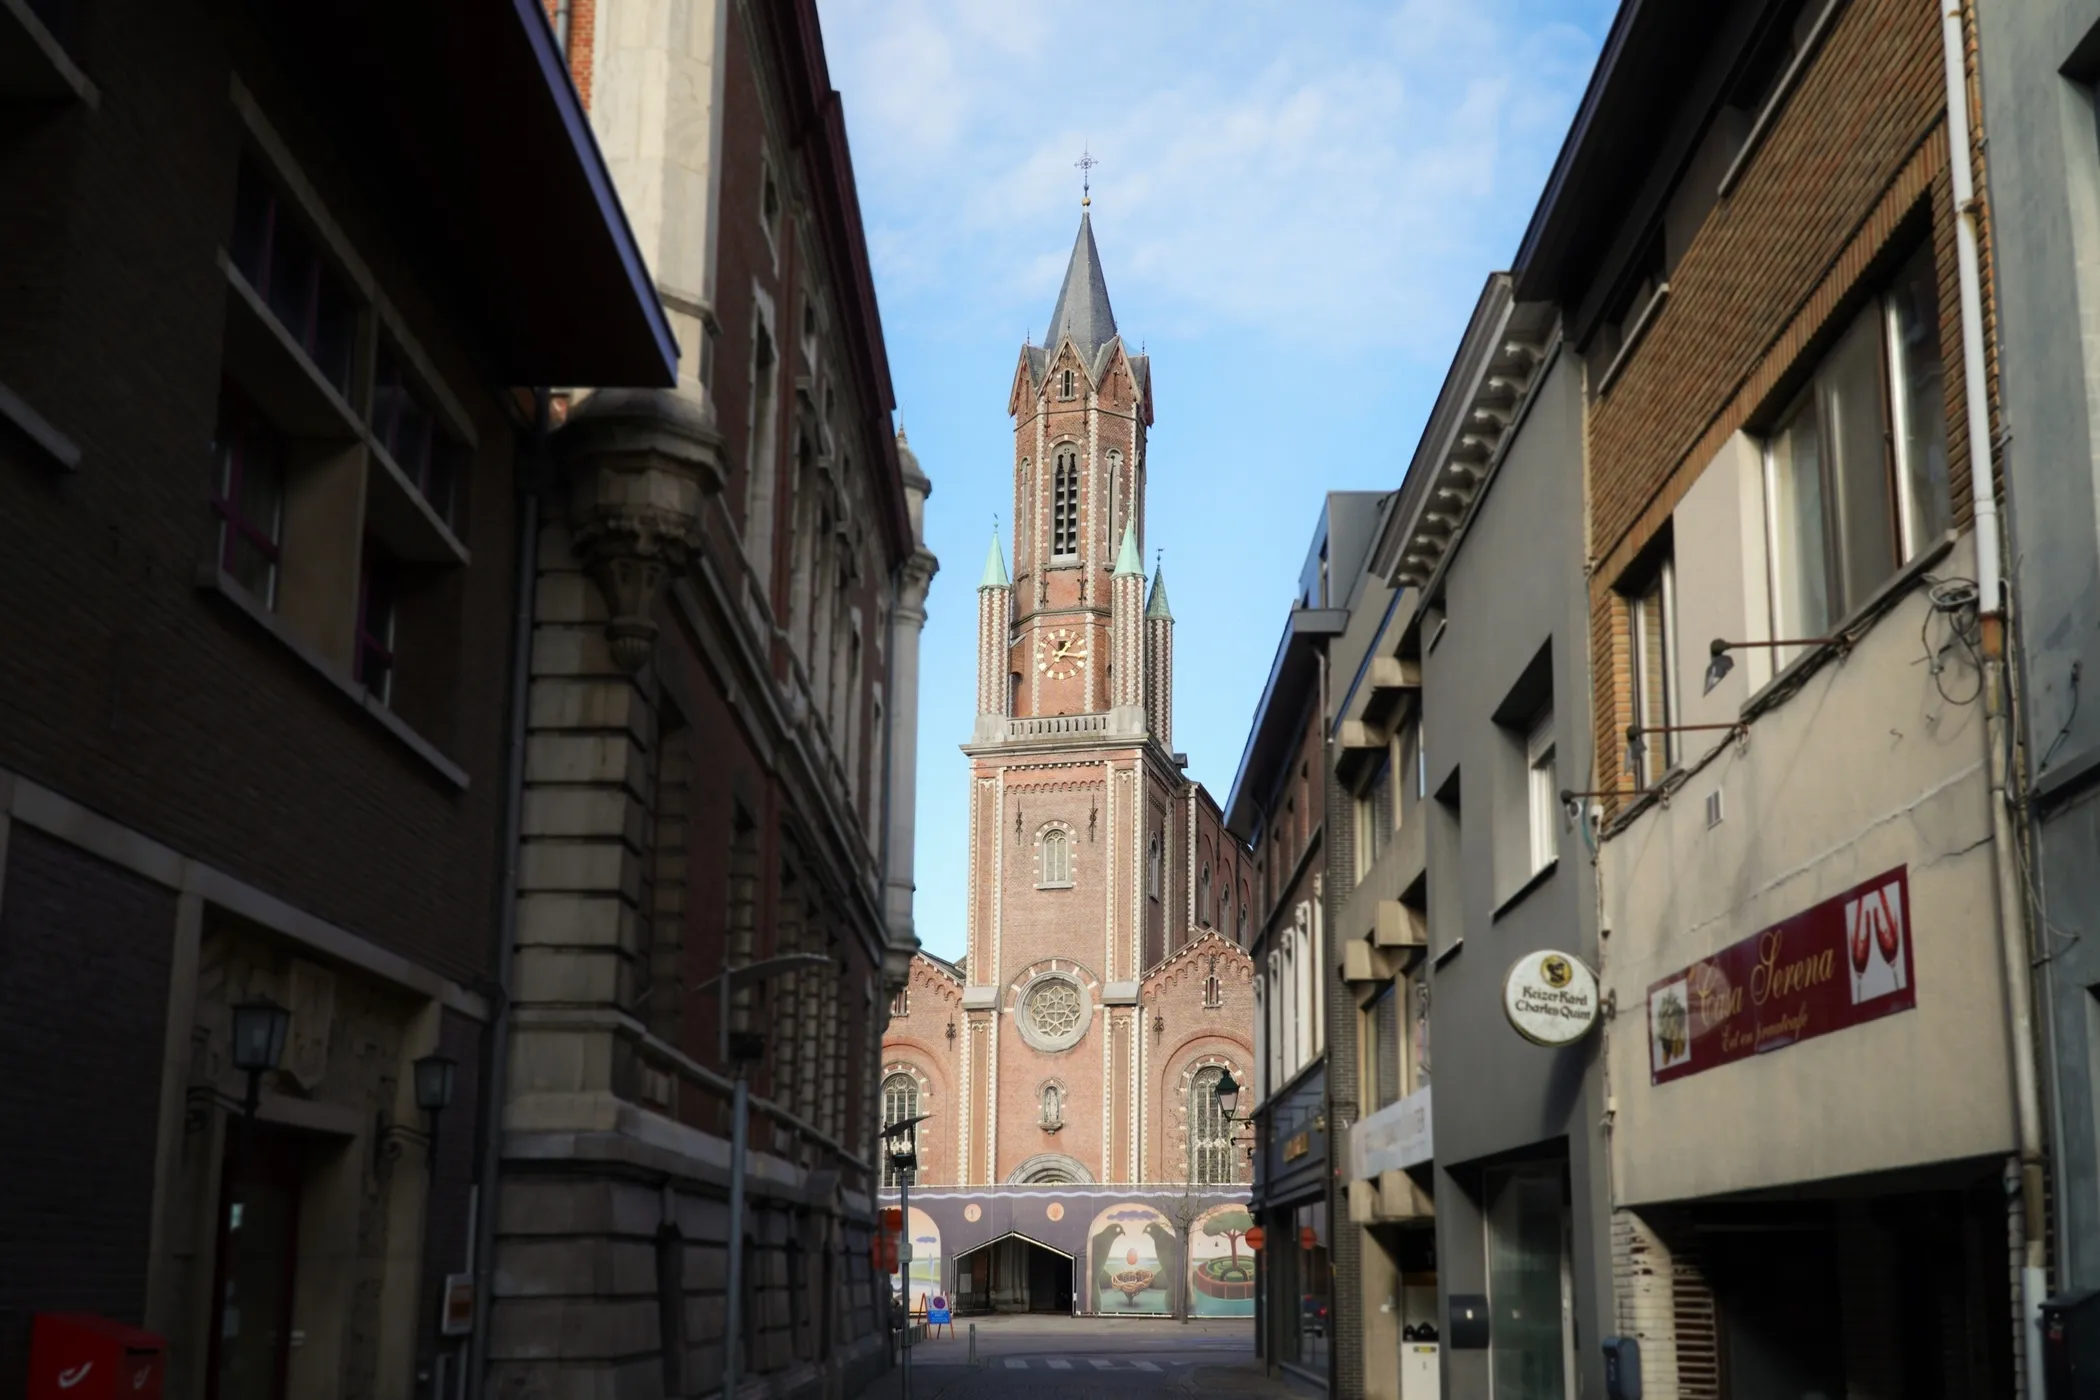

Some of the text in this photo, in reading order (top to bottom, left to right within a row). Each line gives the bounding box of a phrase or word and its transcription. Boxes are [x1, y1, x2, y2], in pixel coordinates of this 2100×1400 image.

[1750, 929, 1836, 1005] Serena
[1522, 985, 1588, 1006] Keizer Karel
[1515, 999, 1591, 1020] Charles Quint
